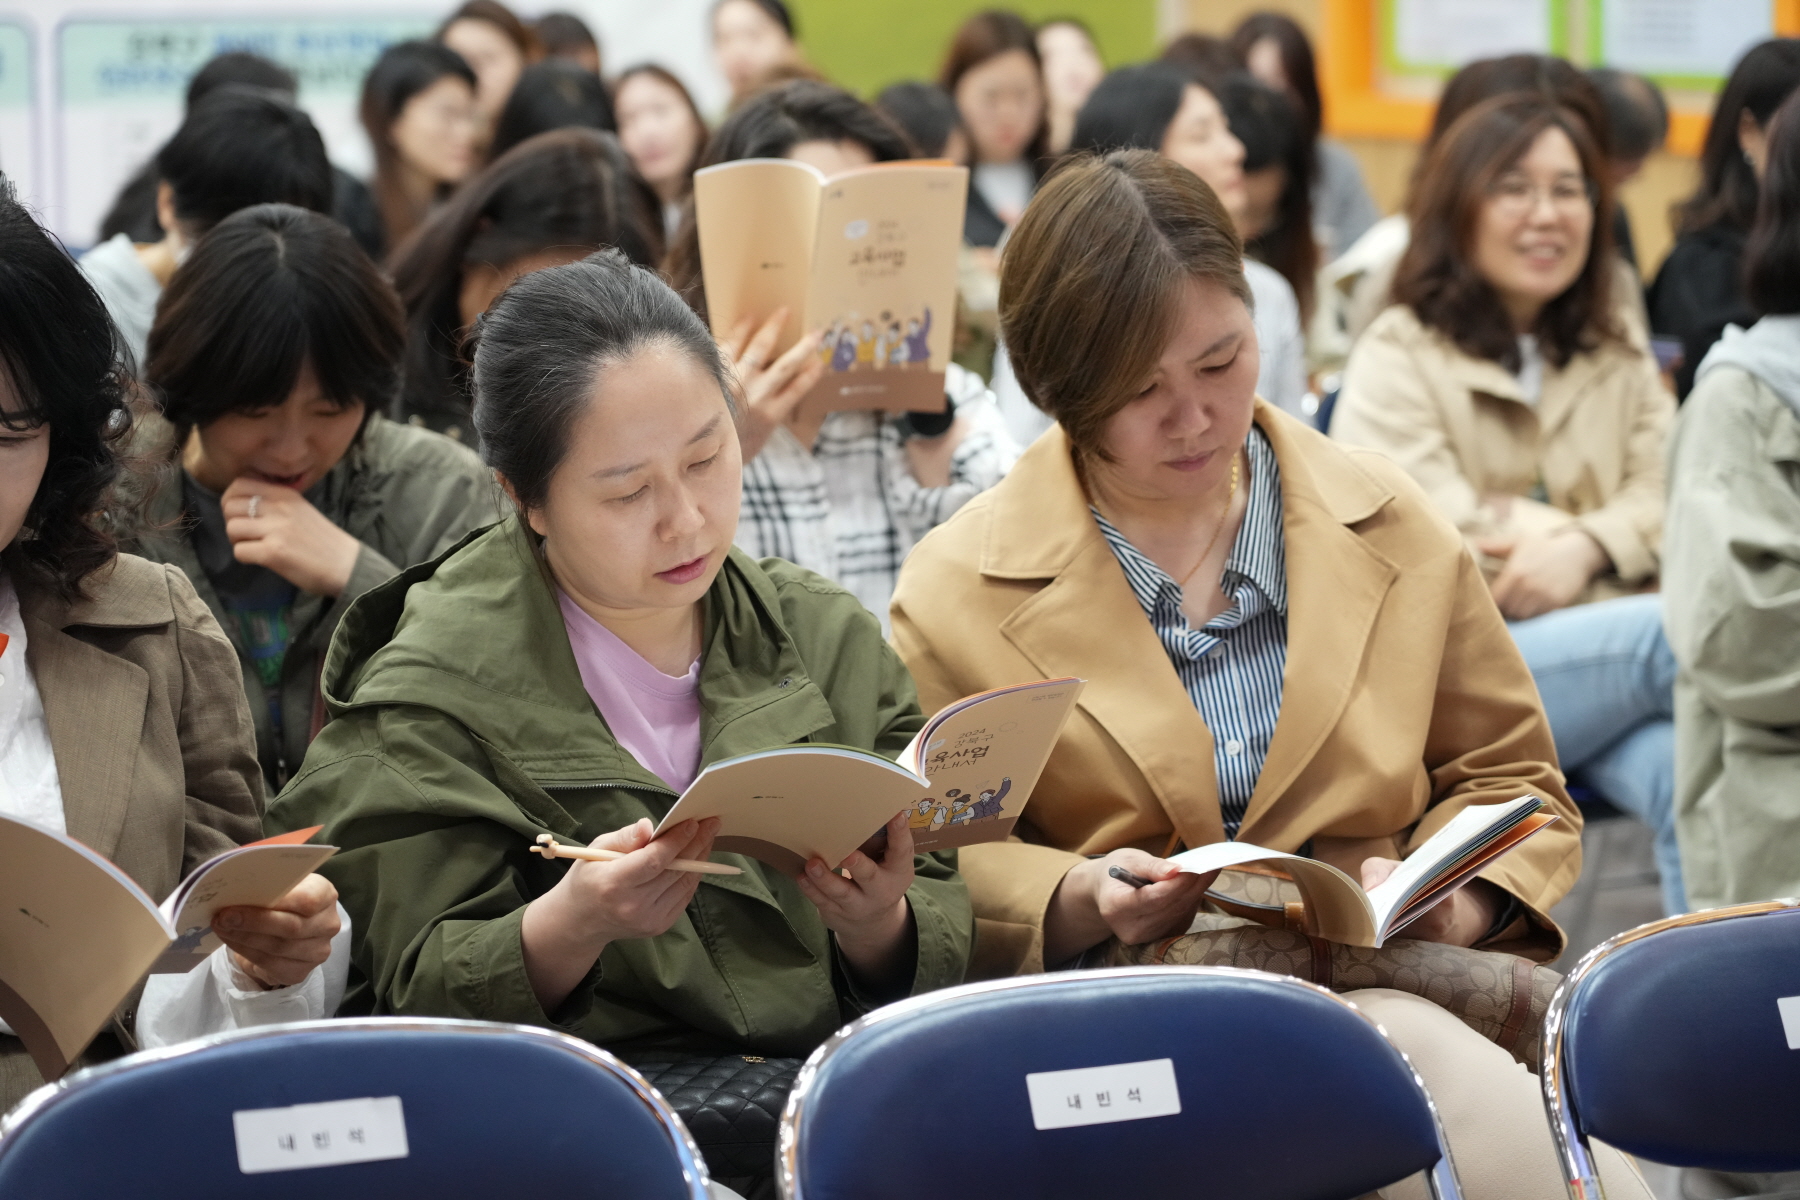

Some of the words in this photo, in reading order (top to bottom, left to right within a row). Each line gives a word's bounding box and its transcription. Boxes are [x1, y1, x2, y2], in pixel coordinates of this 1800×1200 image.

[954, 733, 994, 748] 강북구
[957, 728, 986, 739] 2024
[925, 745, 990, 766] 육사업
